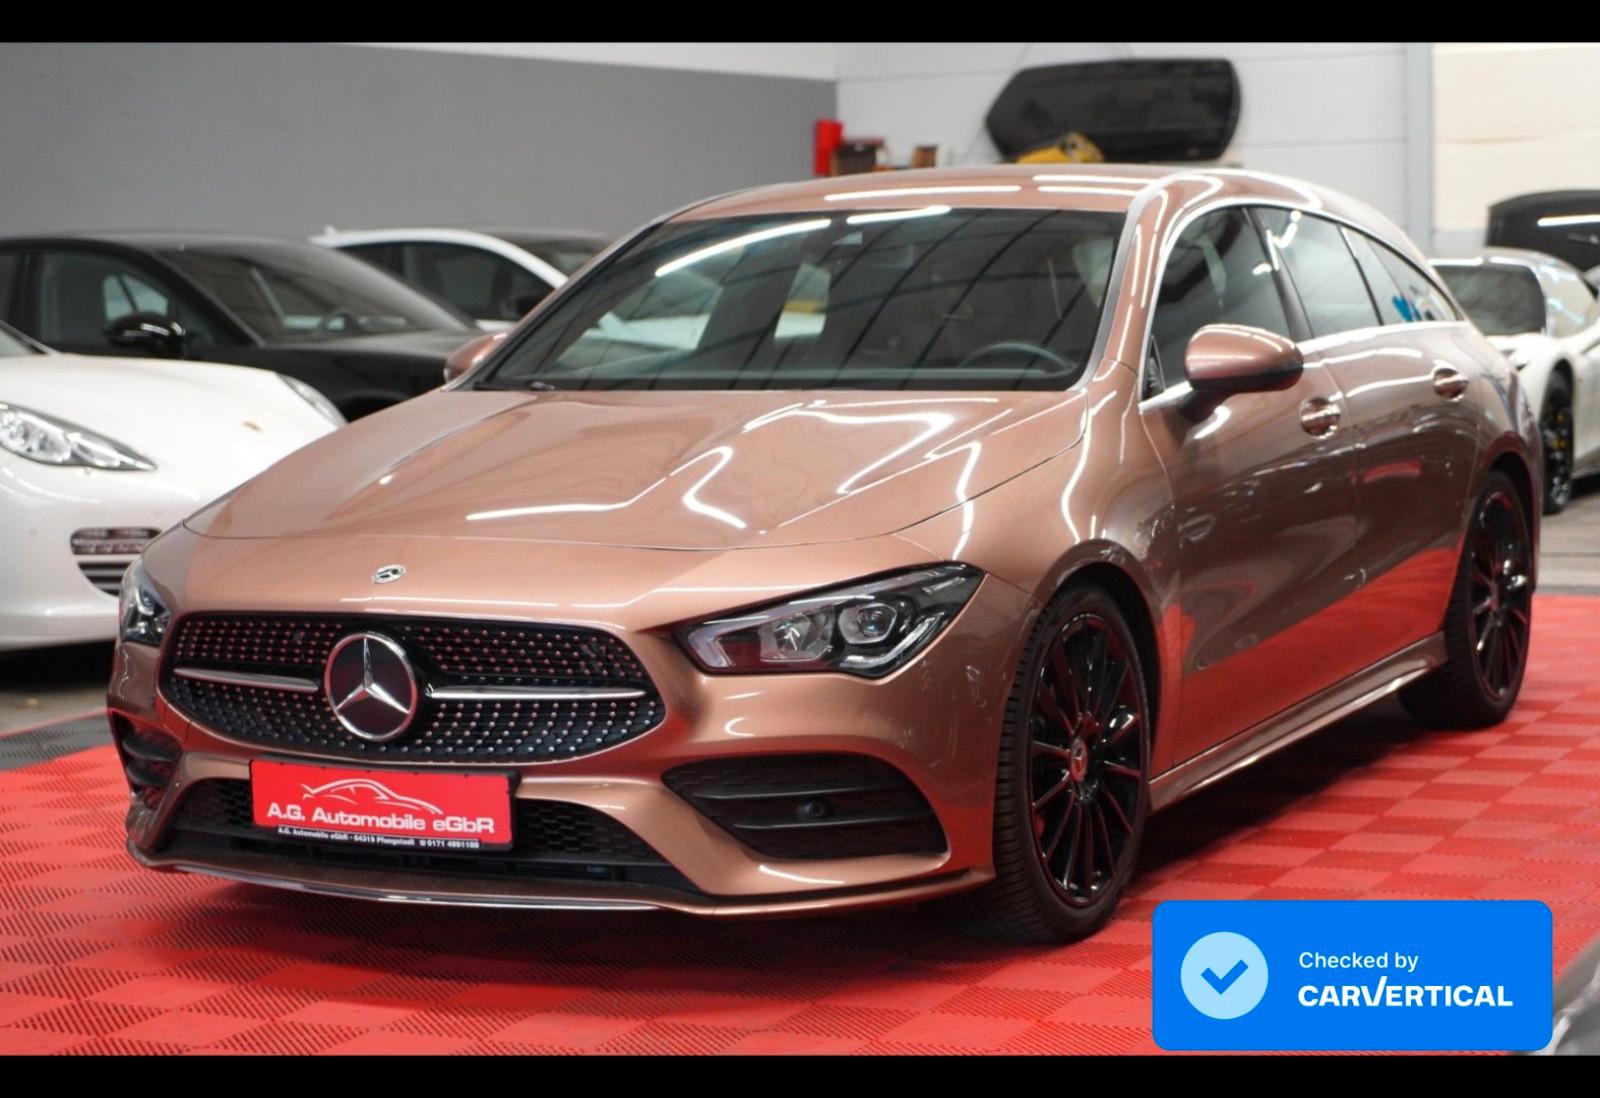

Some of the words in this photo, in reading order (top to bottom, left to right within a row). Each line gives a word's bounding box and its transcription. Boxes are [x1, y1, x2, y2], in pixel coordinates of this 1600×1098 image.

[266, 802, 306, 821] A.G.
[311, 807, 427, 831] Automobile
[432, 816, 495, 834] eGbR
